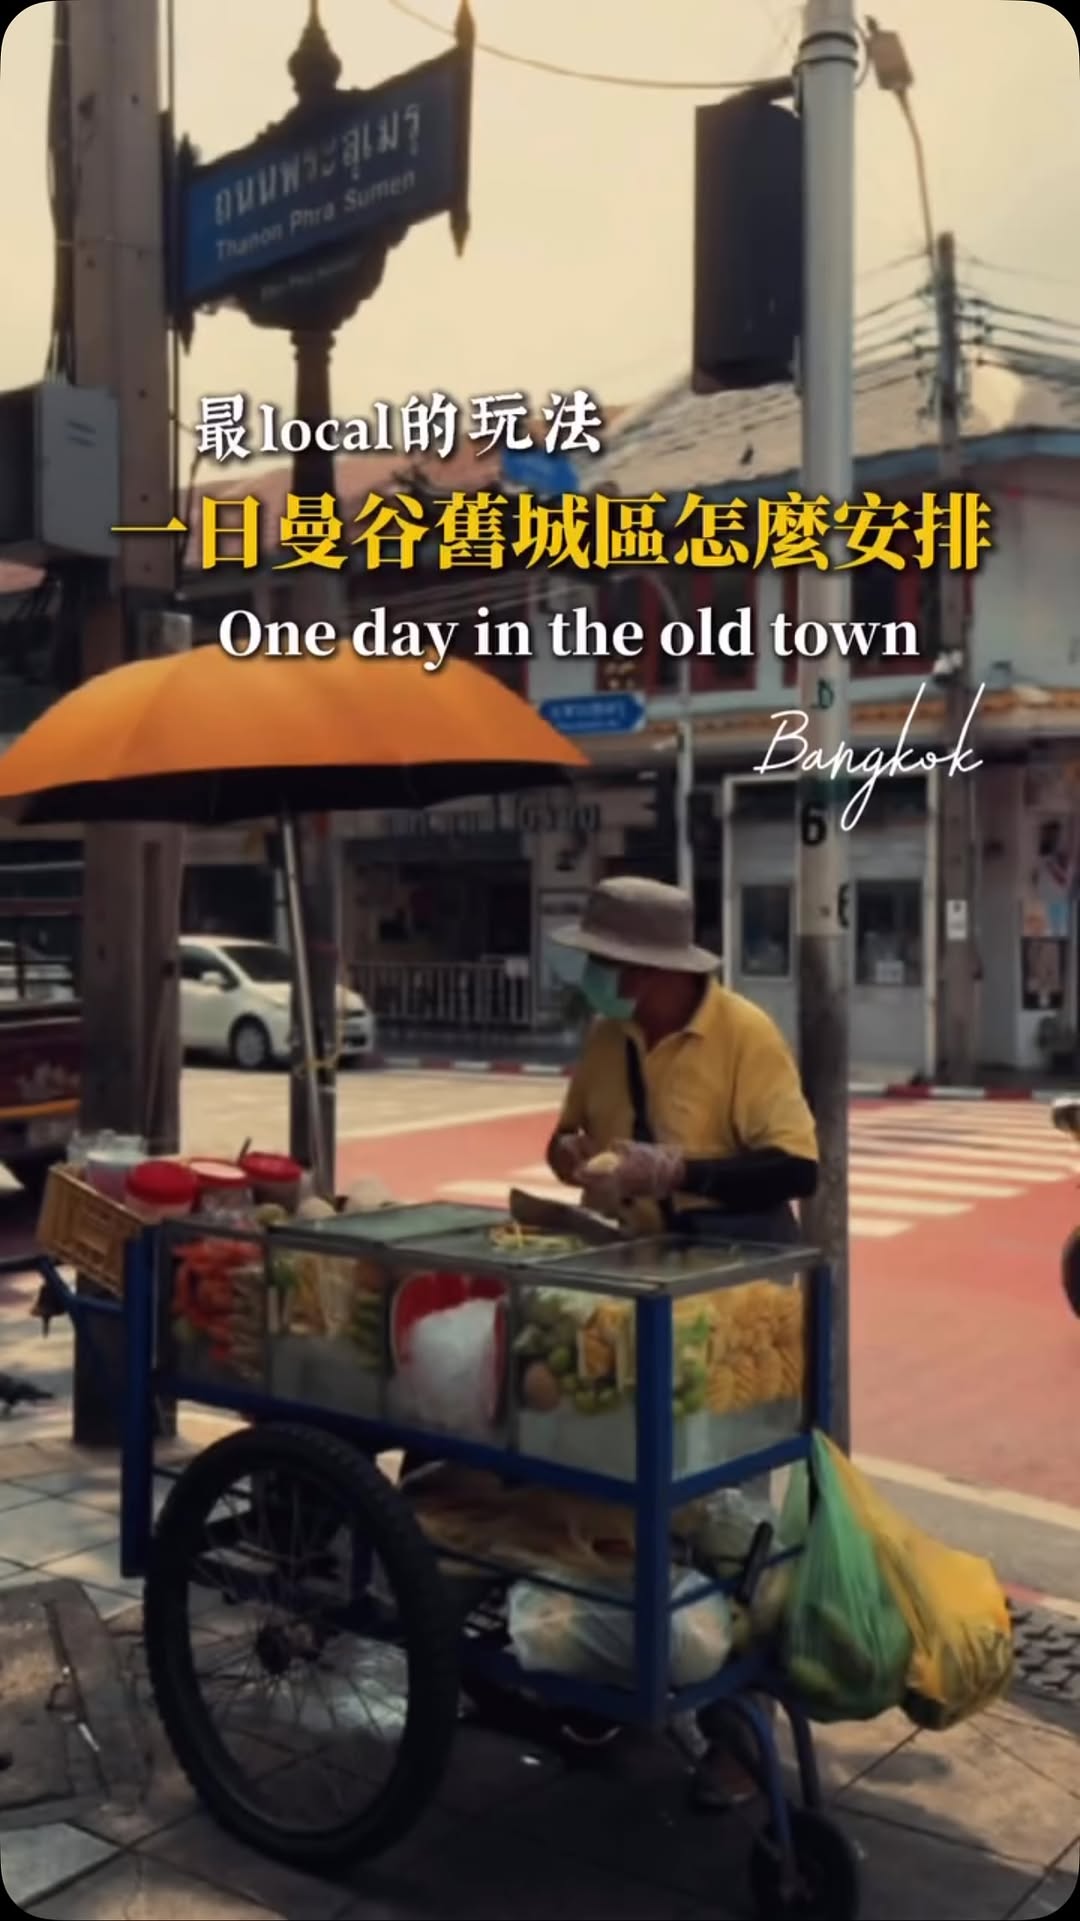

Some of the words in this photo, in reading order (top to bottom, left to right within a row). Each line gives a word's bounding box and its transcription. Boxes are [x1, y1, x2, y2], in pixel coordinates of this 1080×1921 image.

[216, 223, 284, 262] Thanon
[289, 202, 336, 237] Phra
[344, 169, 416, 212] Sumen
